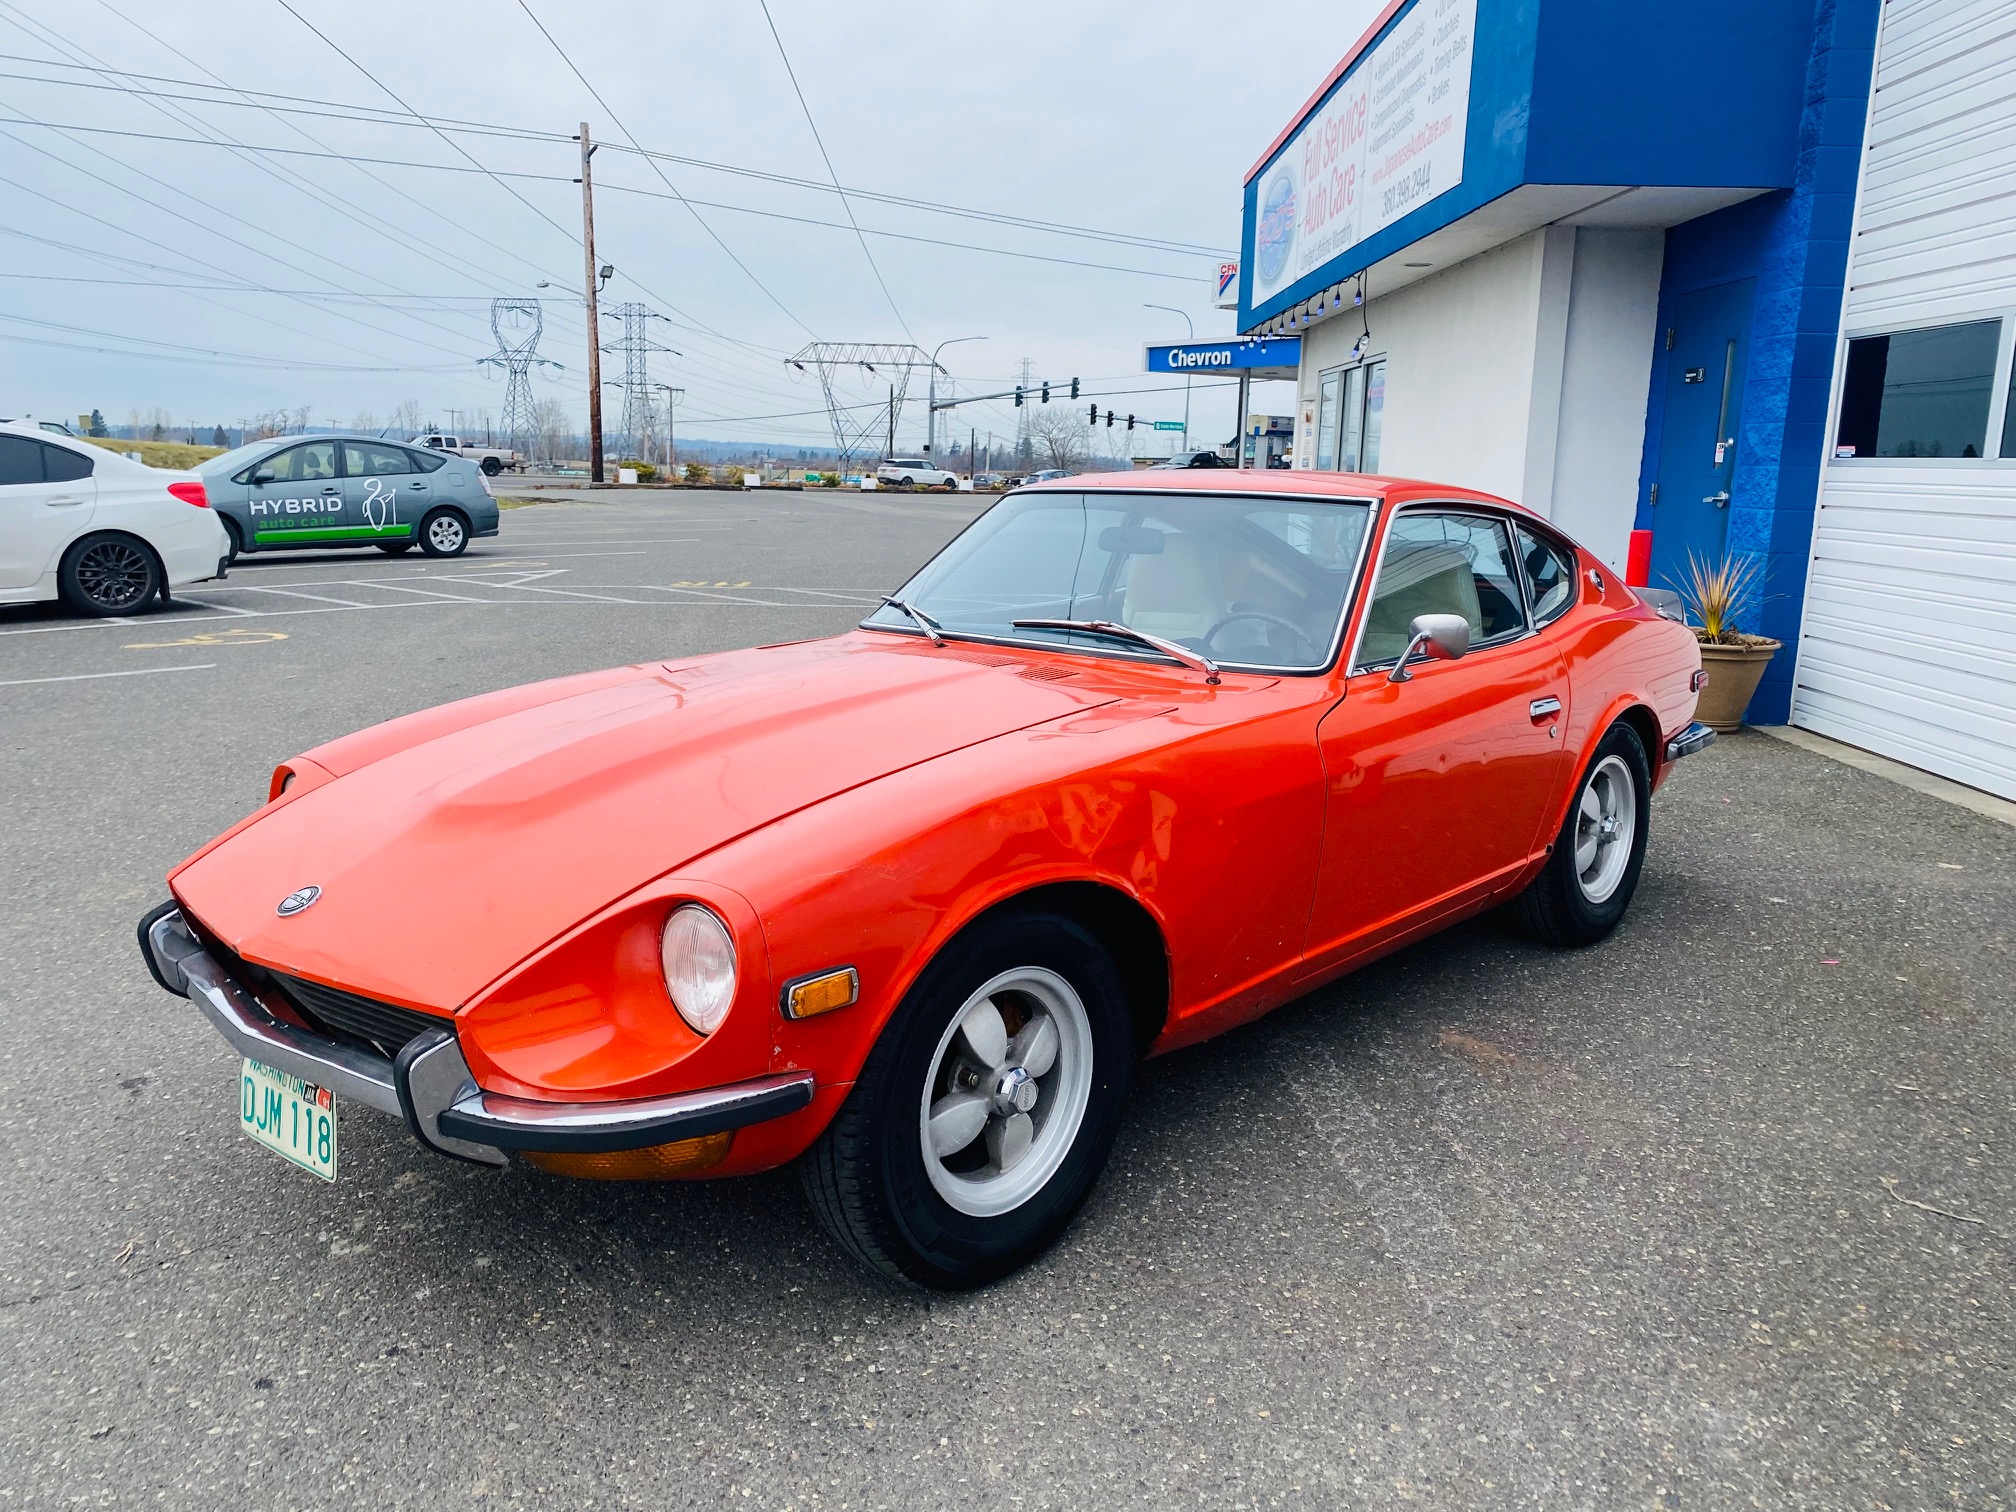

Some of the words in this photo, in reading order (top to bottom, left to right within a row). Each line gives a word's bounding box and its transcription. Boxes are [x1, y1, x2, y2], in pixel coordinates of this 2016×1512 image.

[1436, 14, 1459, 47] Clutches
[1434, 48, 1451, 75] Timing
[1452, 34, 1467, 60] Belts
[1431, 78, 1449, 105] Brakes
[1304, 127, 1322, 187] Full
[1323, 93, 1366, 169] Service
[1304, 187, 1326, 238] Auto
[1329, 163, 1355, 219] Care
[1382, 160, 1431, 217] 360.398.2944
[1220, 264, 1238, 274] CFN
[1168, 349, 1231, 367] Chevron
[249, 497, 342, 515] HYBRID
[259, 518, 295, 529] auto
[301, 516, 336, 527] care
[249, 1060, 305, 1098] WASHINGTON
[243, 1075, 283, 1139] DJM
[292, 1101, 331, 1164] 118
